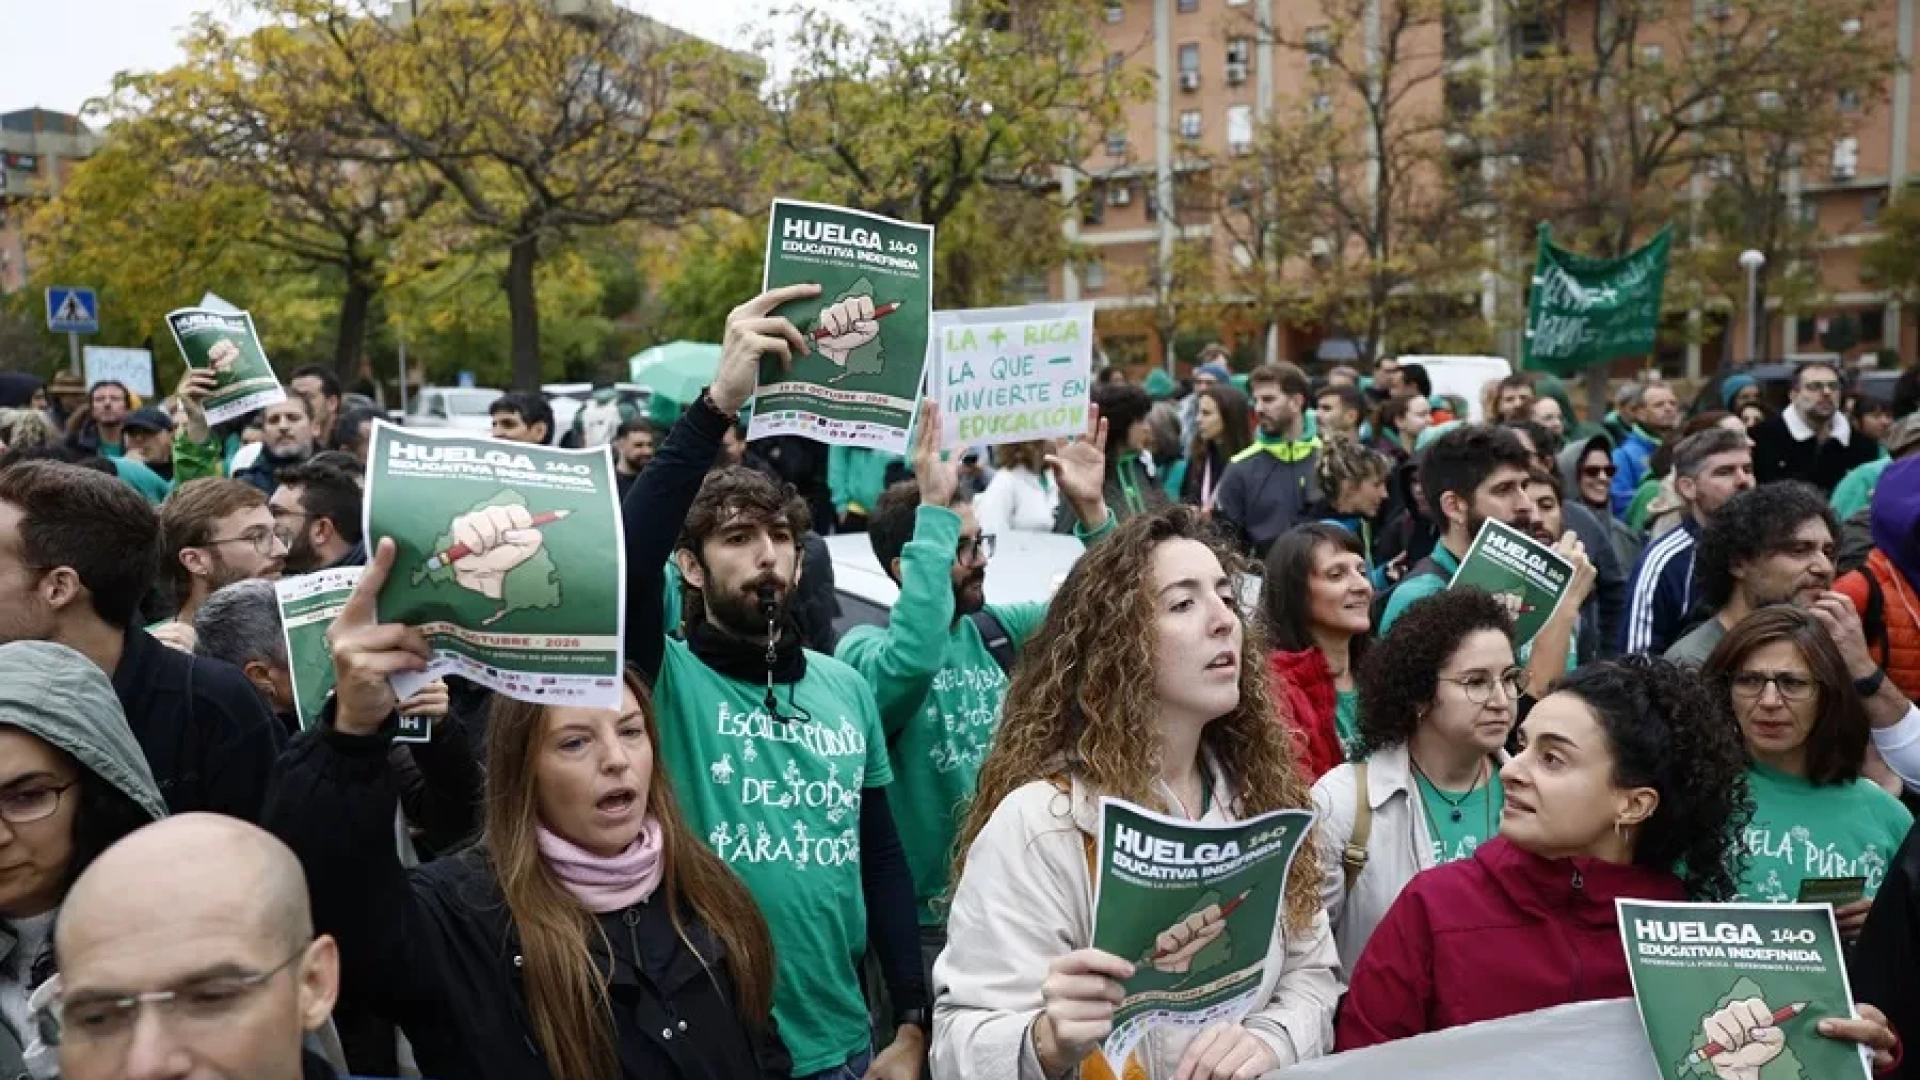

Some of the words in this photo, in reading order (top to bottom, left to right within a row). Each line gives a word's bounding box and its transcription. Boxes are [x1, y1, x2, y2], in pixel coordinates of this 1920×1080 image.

[783, 218, 882, 251] HUELGA
[782, 240, 854, 259] EDUCATIVA
[857, 249, 919, 270] INDEFINIDA
[945, 328, 977, 352] LA
[1023, 319, 1080, 346] RICA
[947, 360, 975, 386] LA
[990, 354, 1035, 380] QUE
[948, 382, 1052, 412] INVIERTE
[1062, 376, 1086, 398] EN
[389, 440, 536, 471] HUELGA
[388, 459, 492, 474] EDUCATIVA
[495, 465, 594, 486] INDEFINIDA
[1486, 531, 1547, 573] HUELGA
[460, 629, 529, 646] OCTUBRE
[742, 777, 781, 806] DE
[710, 832, 793, 863] PARA
[1113, 850, 1198, 880] EDUCATIVA
[1202, 840, 1282, 877] INDEFINIDA
[1115, 823, 1240, 866] HUELGA
[1805, 842, 1883, 889] PÚBLIC
[1634, 919, 1763, 945] HUELGA
[1638, 942, 1727, 958] EDUCATIVA
[1728, 947, 1822, 963] INDEFINIDA
